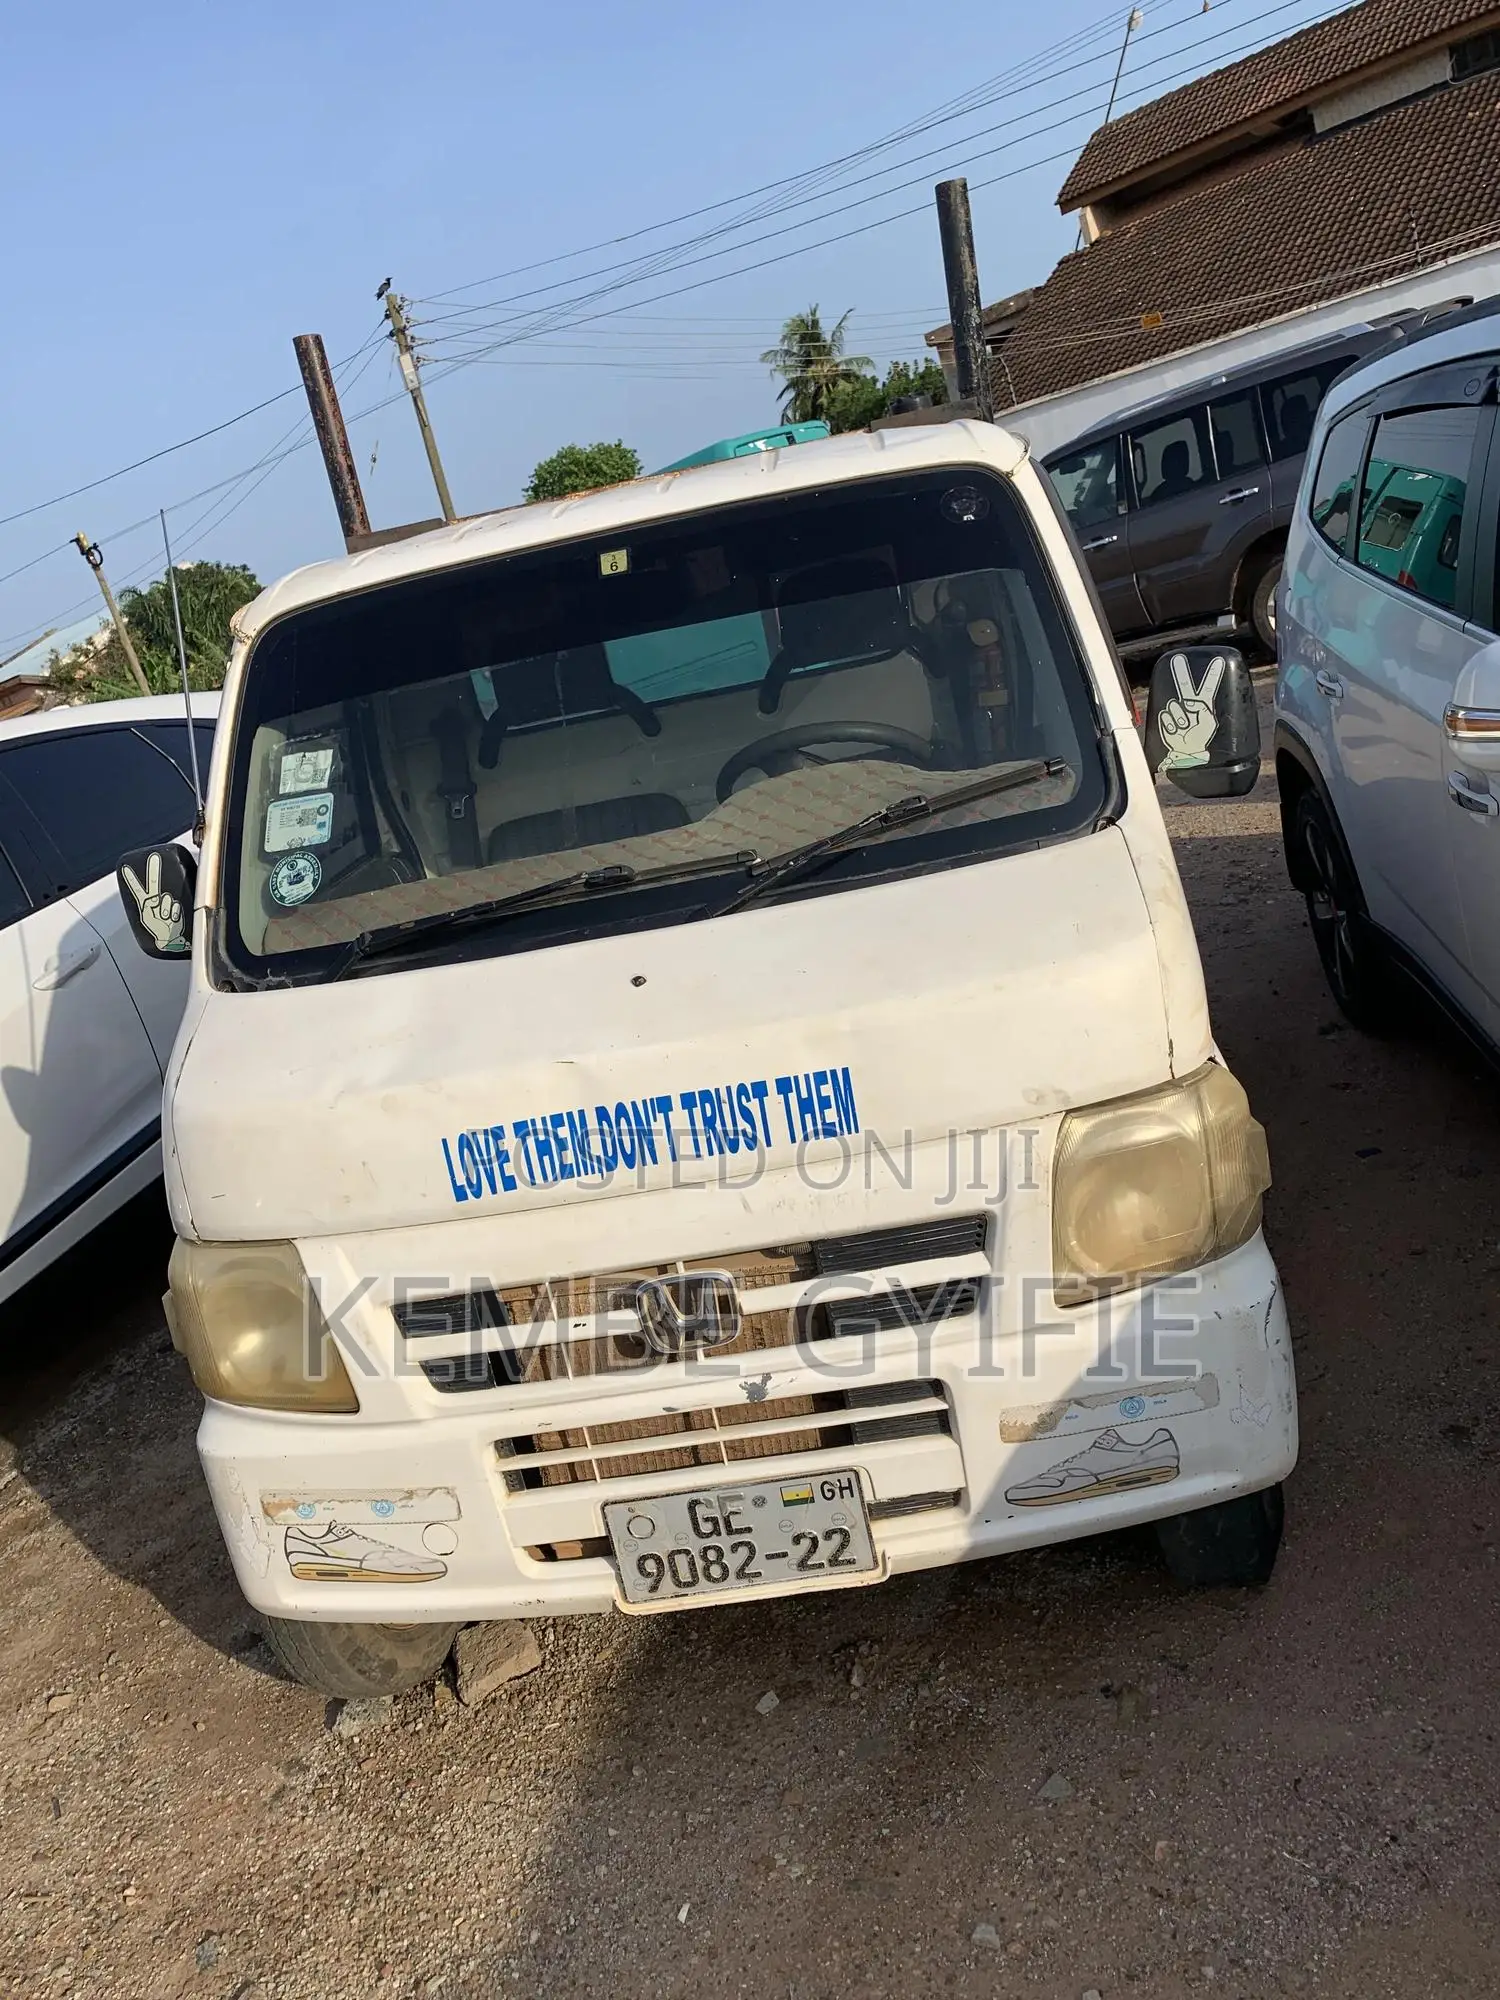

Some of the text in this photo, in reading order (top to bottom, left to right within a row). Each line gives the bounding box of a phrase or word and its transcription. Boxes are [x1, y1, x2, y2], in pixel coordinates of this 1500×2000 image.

[610, 562, 618, 571] 6
[441, 1125, 518, 1202] LOVE
[680, 1080, 772, 1158] TRUST
[775, 1067, 859, 1144] THEM
[820, 1477, 855, 1501] GH
[687, 1492, 753, 1539] GE
[636, 1527, 857, 1593] 9082-22
